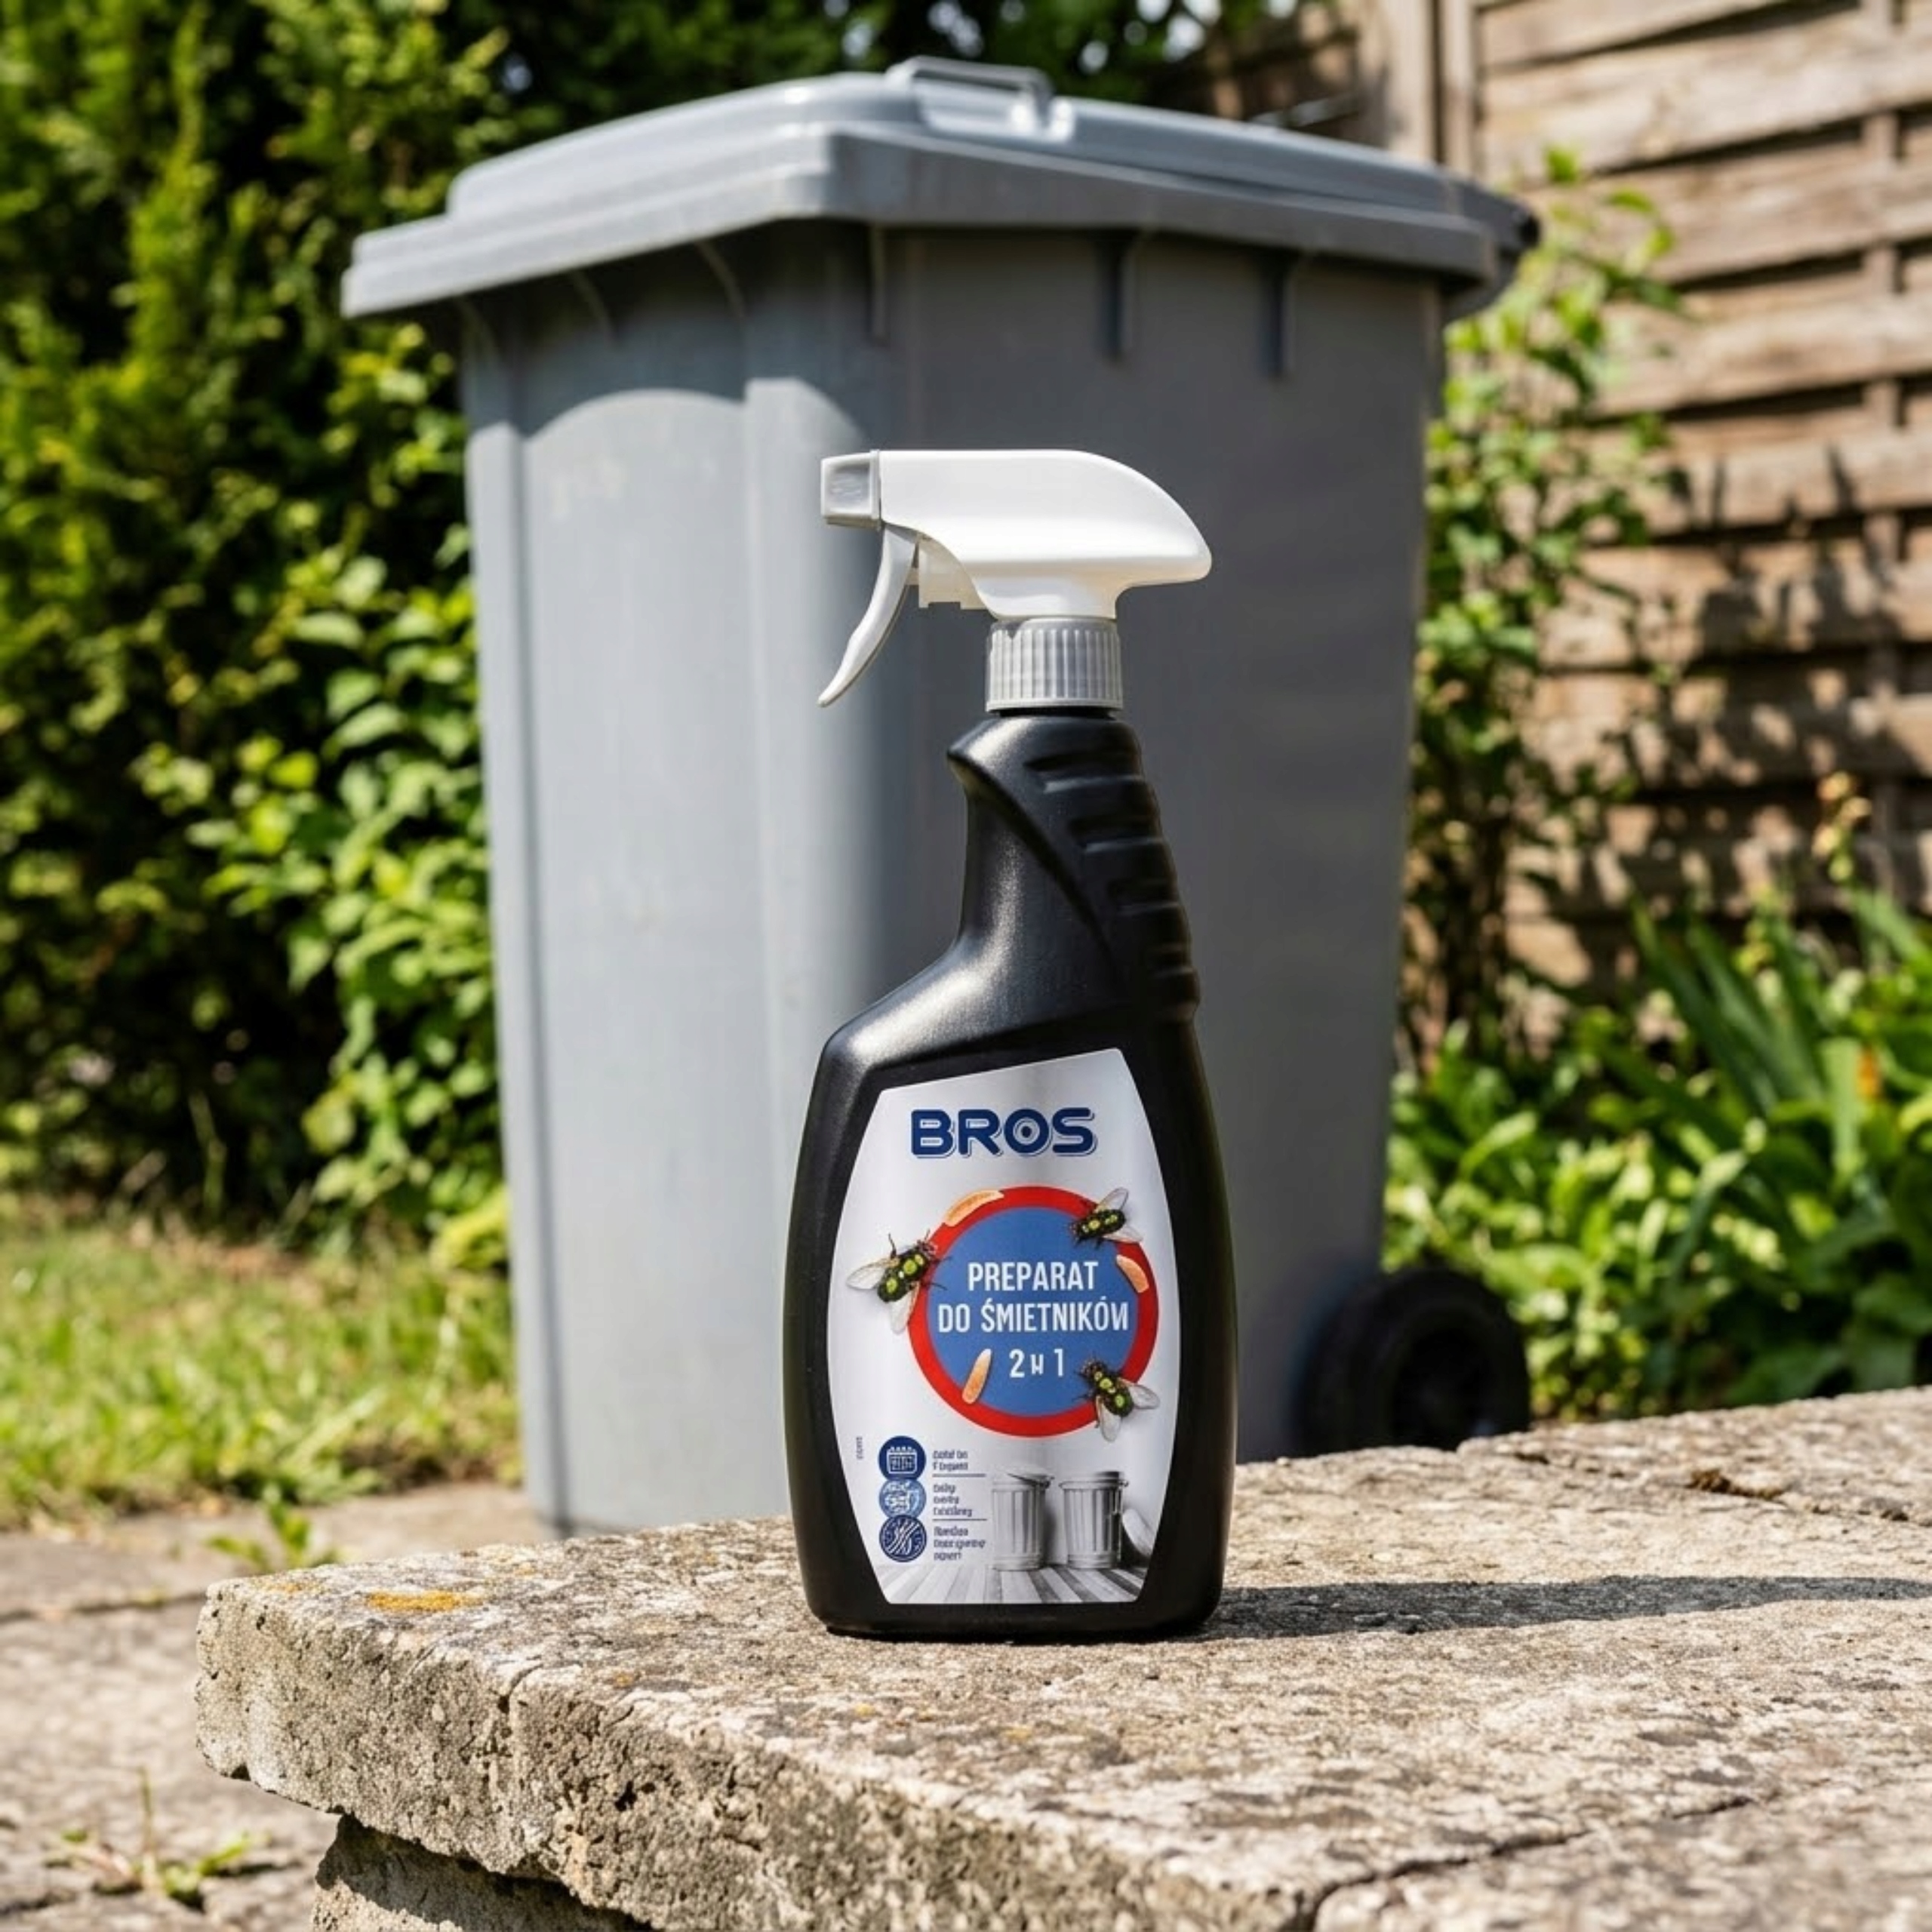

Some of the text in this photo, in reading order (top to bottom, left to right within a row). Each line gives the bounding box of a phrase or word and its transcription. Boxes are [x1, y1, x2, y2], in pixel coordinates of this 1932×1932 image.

[911, 1107, 1097, 1158] BROS
[968, 1261, 1099, 1291] PREPARAT
[938, 1296, 1129, 1333] DO ŚMIETNIKÓW
[1009, 1349, 1025, 1378] 2
[1054, 1348, 1064, 1377] 1
